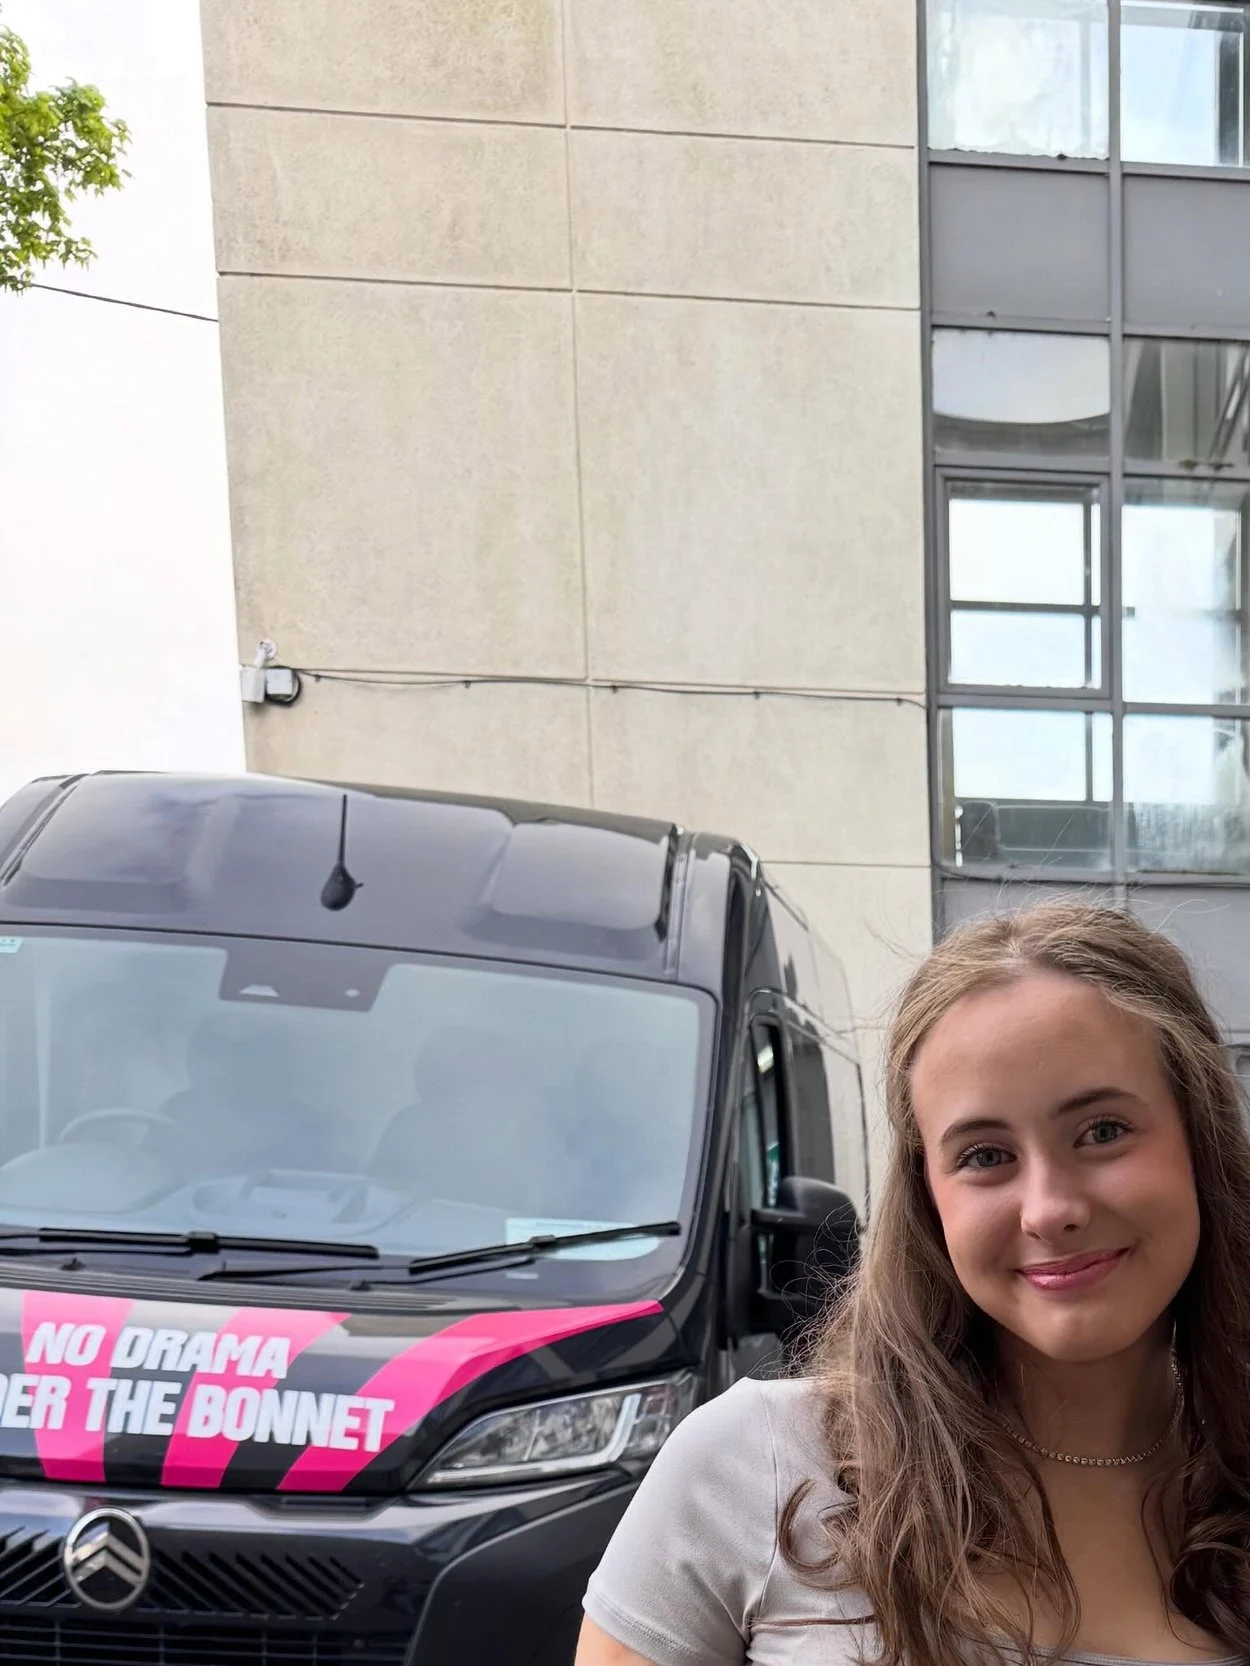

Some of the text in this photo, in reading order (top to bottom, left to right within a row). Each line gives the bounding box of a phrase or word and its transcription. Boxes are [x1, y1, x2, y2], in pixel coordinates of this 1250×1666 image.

[25, 1322, 292, 1380] NO DRAMA
[0, 1373, 395, 1453] ER THE BONNET
